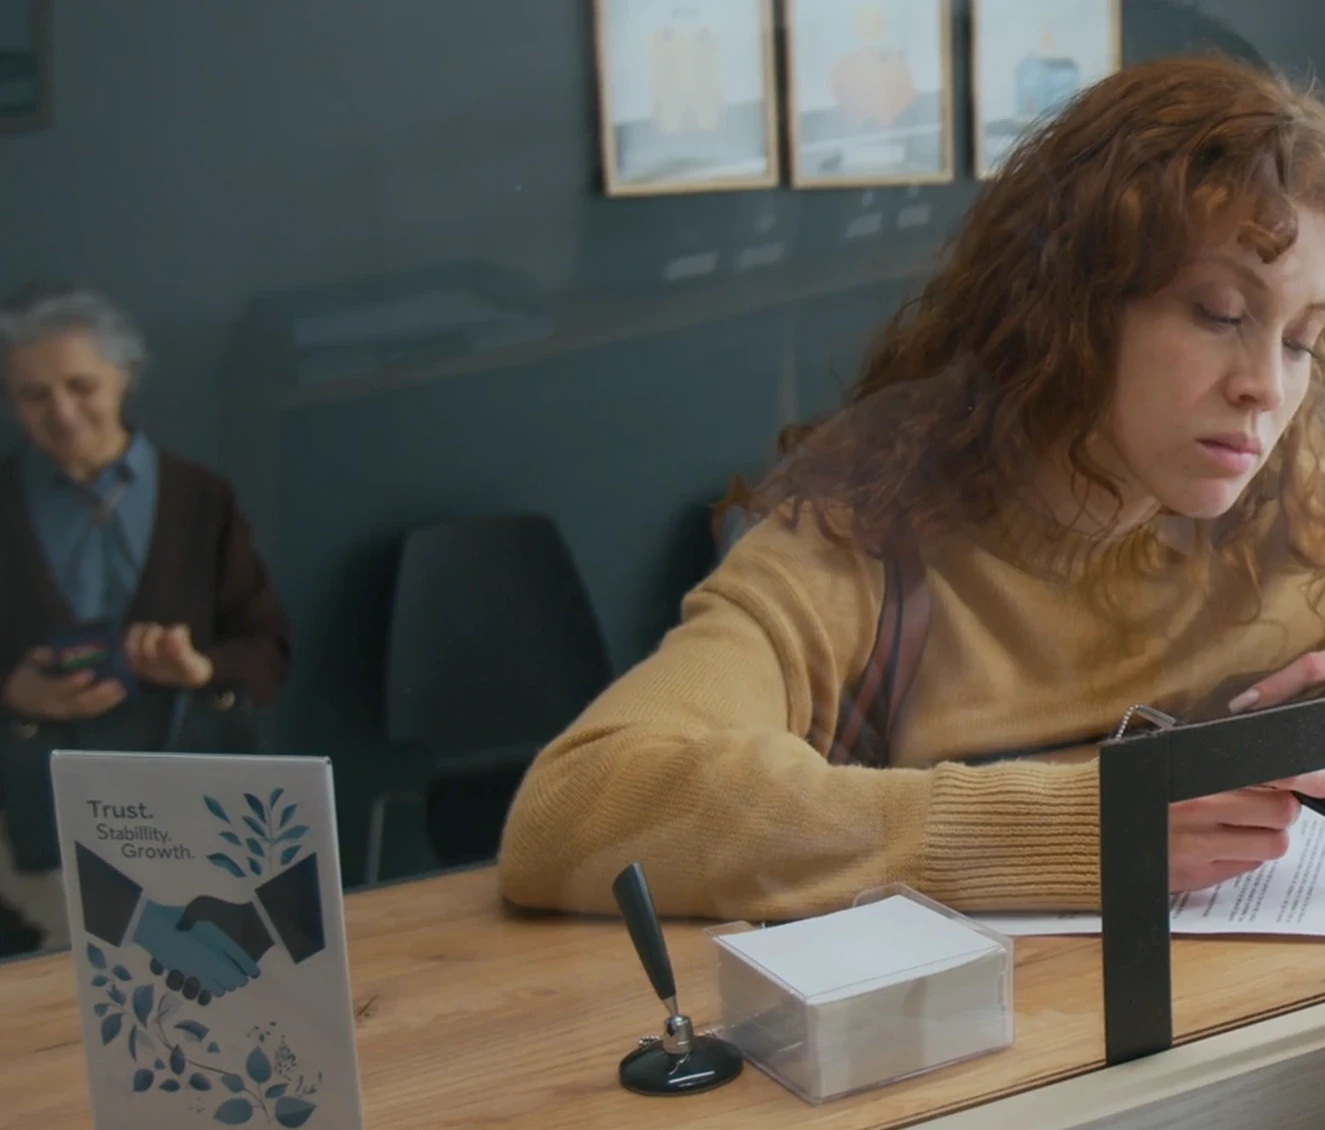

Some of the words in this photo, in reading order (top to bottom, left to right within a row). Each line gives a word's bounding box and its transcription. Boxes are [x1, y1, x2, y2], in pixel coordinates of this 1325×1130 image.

[86, 800, 154, 819] Trust.
[96, 823, 172, 844] Stabillity.
[121, 843, 196, 860] Growth.
